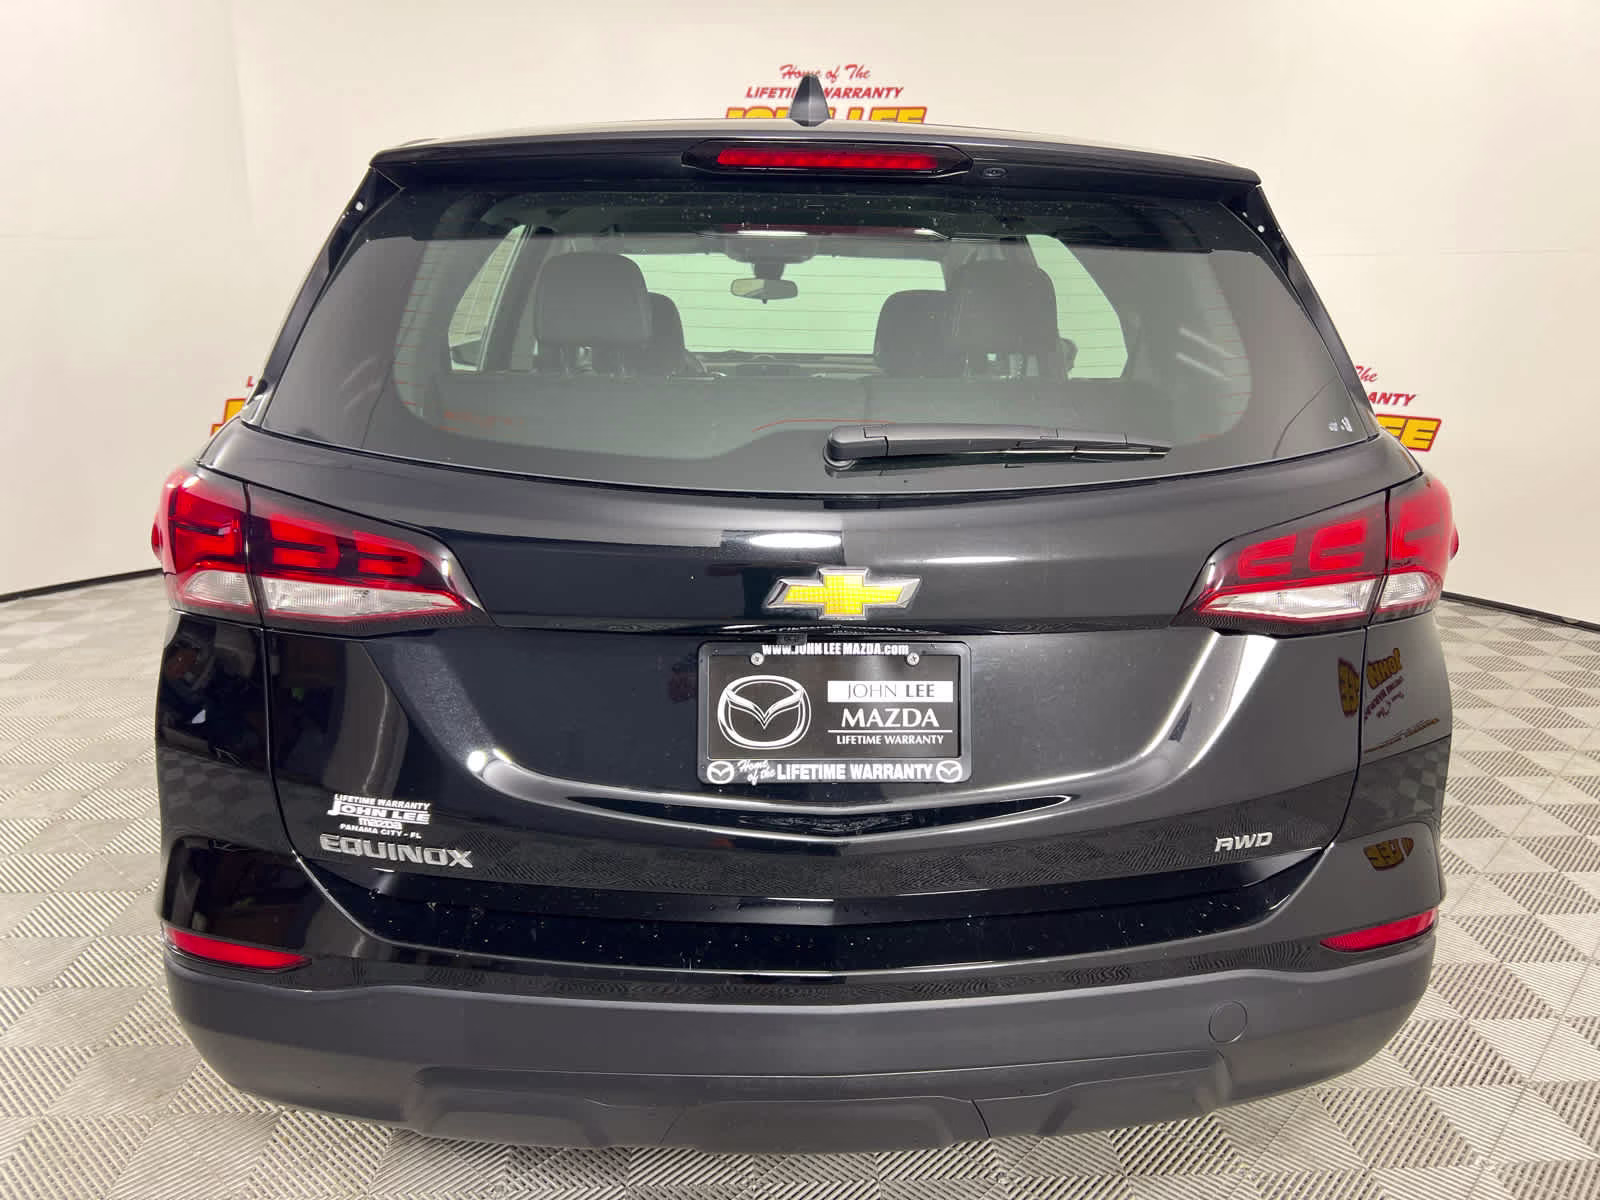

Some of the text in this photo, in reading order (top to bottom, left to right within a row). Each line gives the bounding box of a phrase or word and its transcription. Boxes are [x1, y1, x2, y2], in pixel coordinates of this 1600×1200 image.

[825, 65, 840, 83] of
[845, 64, 871, 79] The
[745, 86, 797, 98] LIFETI
[848, 684, 935, 698] JOHN LEE
[841, 708, 939, 728] MAZDA
[836, 735, 944, 745] LIFETIME WARRANTY
[777, 763, 933, 780] LIFETIME WARRANTY
[334, 793, 431, 811] LIFETIME WARRANTY
[327, 800, 431, 823] JOHN LEE
[339, 823, 378, 835] PANAMA
[380, 828, 402, 837] CITY
[319, 833, 473, 868] EQUINOX
[1214, 832, 1273, 852] AWD
